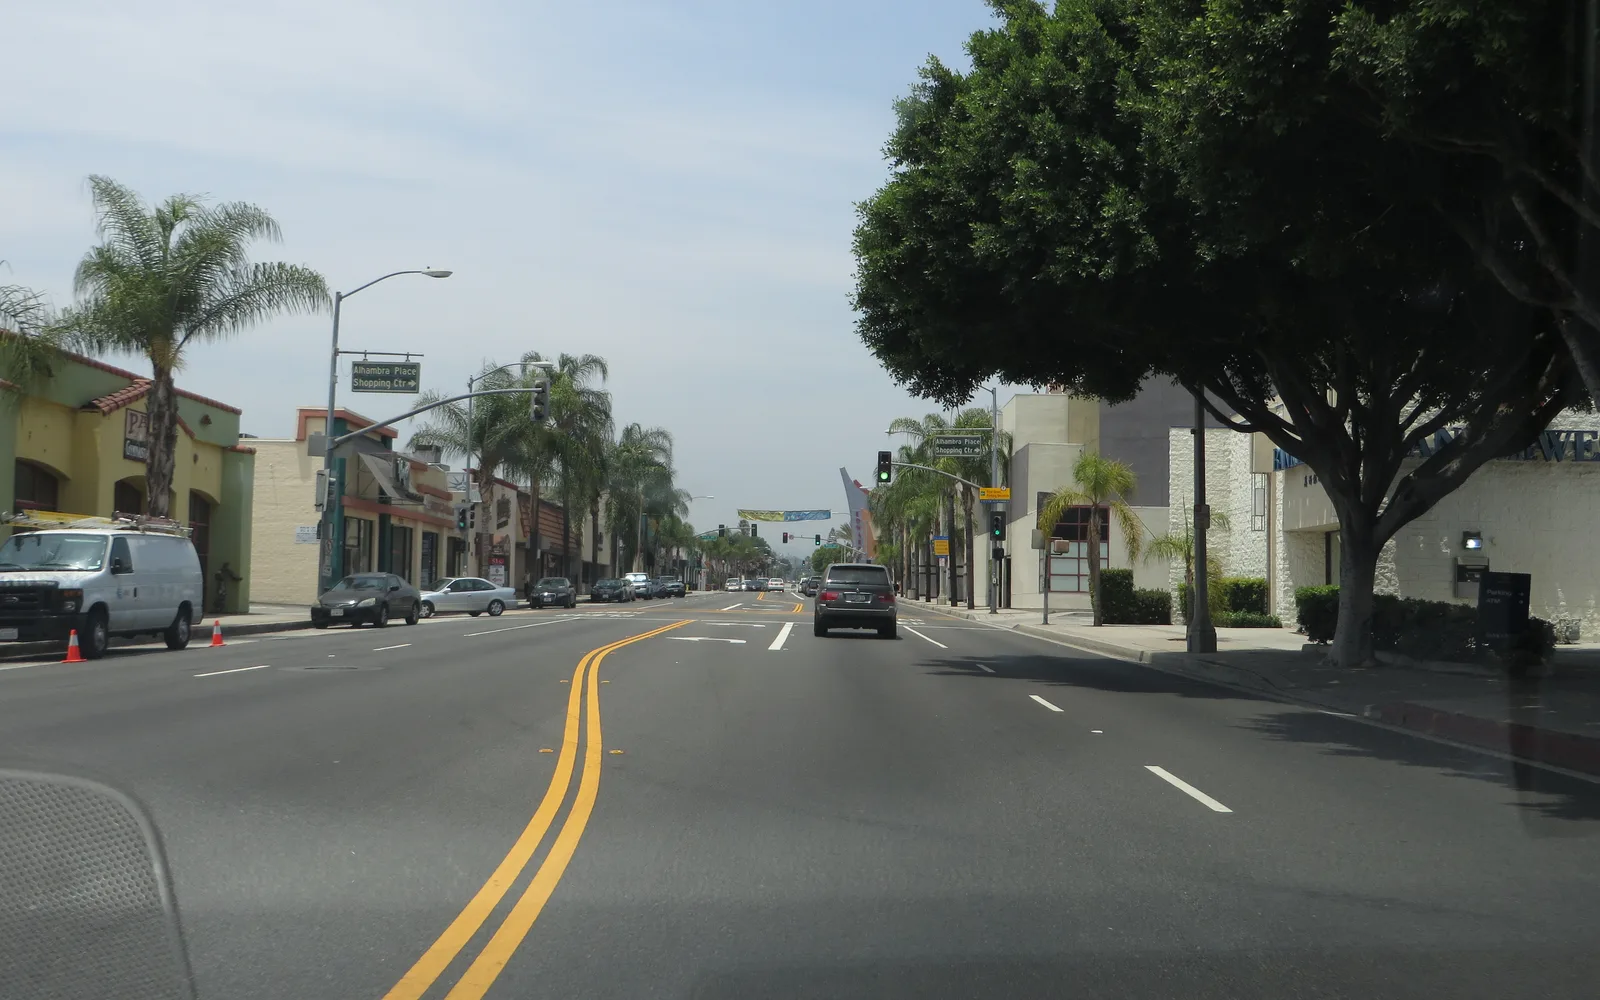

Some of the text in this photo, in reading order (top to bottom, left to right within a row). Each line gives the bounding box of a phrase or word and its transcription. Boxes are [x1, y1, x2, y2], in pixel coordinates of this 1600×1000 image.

[353, 366, 417, 376] Alhambra Place
[353, 378, 407, 390] Shopping Ctr
[935, 446, 973, 455] Shopping Ctr
[1486, 588, 1513, 597] Parking
